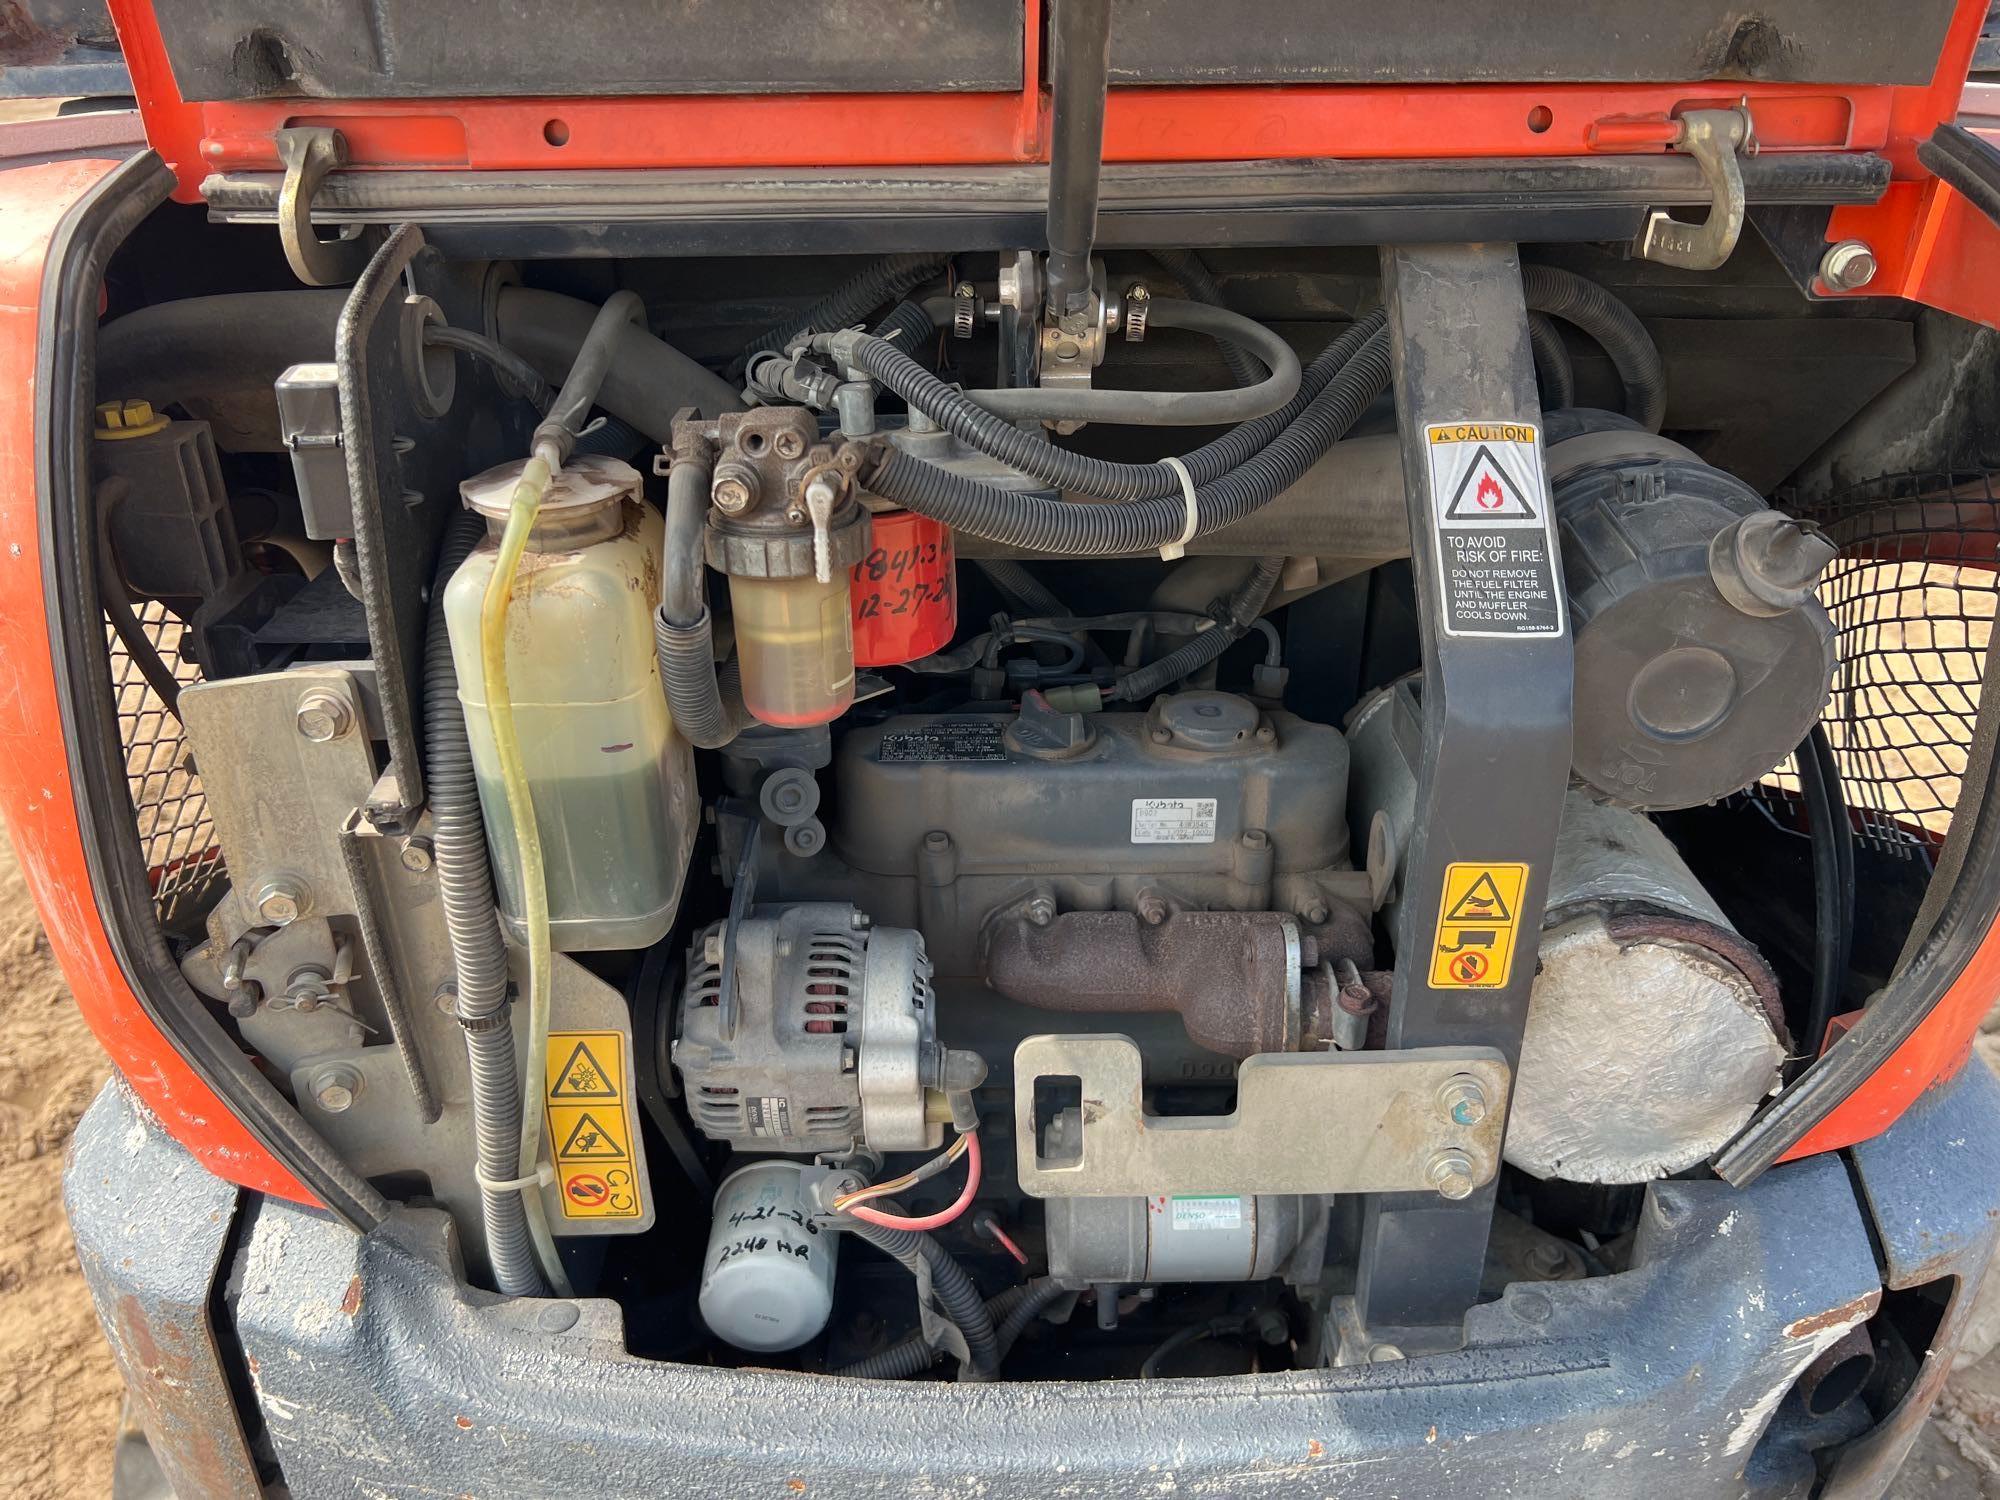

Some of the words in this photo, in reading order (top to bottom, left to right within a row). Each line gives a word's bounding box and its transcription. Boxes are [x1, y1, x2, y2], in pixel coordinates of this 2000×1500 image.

[1455, 427, 1527, 441] CAUTION
[1447, 536, 1465, 548] TO
[1467, 536, 1506, 548] AVOID
[1457, 550, 1486, 562] RISK
[1489, 550, 1507, 562] OF
[1511, 551, 1544, 563] FIRE:
[1452, 570, 1467, 578] DO
[1469, 570, 1490, 578] NOT
[1493, 570, 1538, 578] REMOVE
[1453, 580, 1473, 588] THE
[1475, 580, 1501, 589] FUEL
[1503, 580, 1539, 589] FILTER
[1454, 591, 1483, 599] UNTIL
[1484, 591, 1506, 599] THE
[1508, 591, 1548, 599] ENGINE
[1455, 601, 1476, 609] AND
[1478, 601, 1528, 610] MUFFLER
[1456, 611, 1491, 620] COOLS
[1494, 611, 1530, 621] DOWN.
[1145, 800, 1184, 809] Kubota
[1176, 1211, 1206, 1220] DENSO
